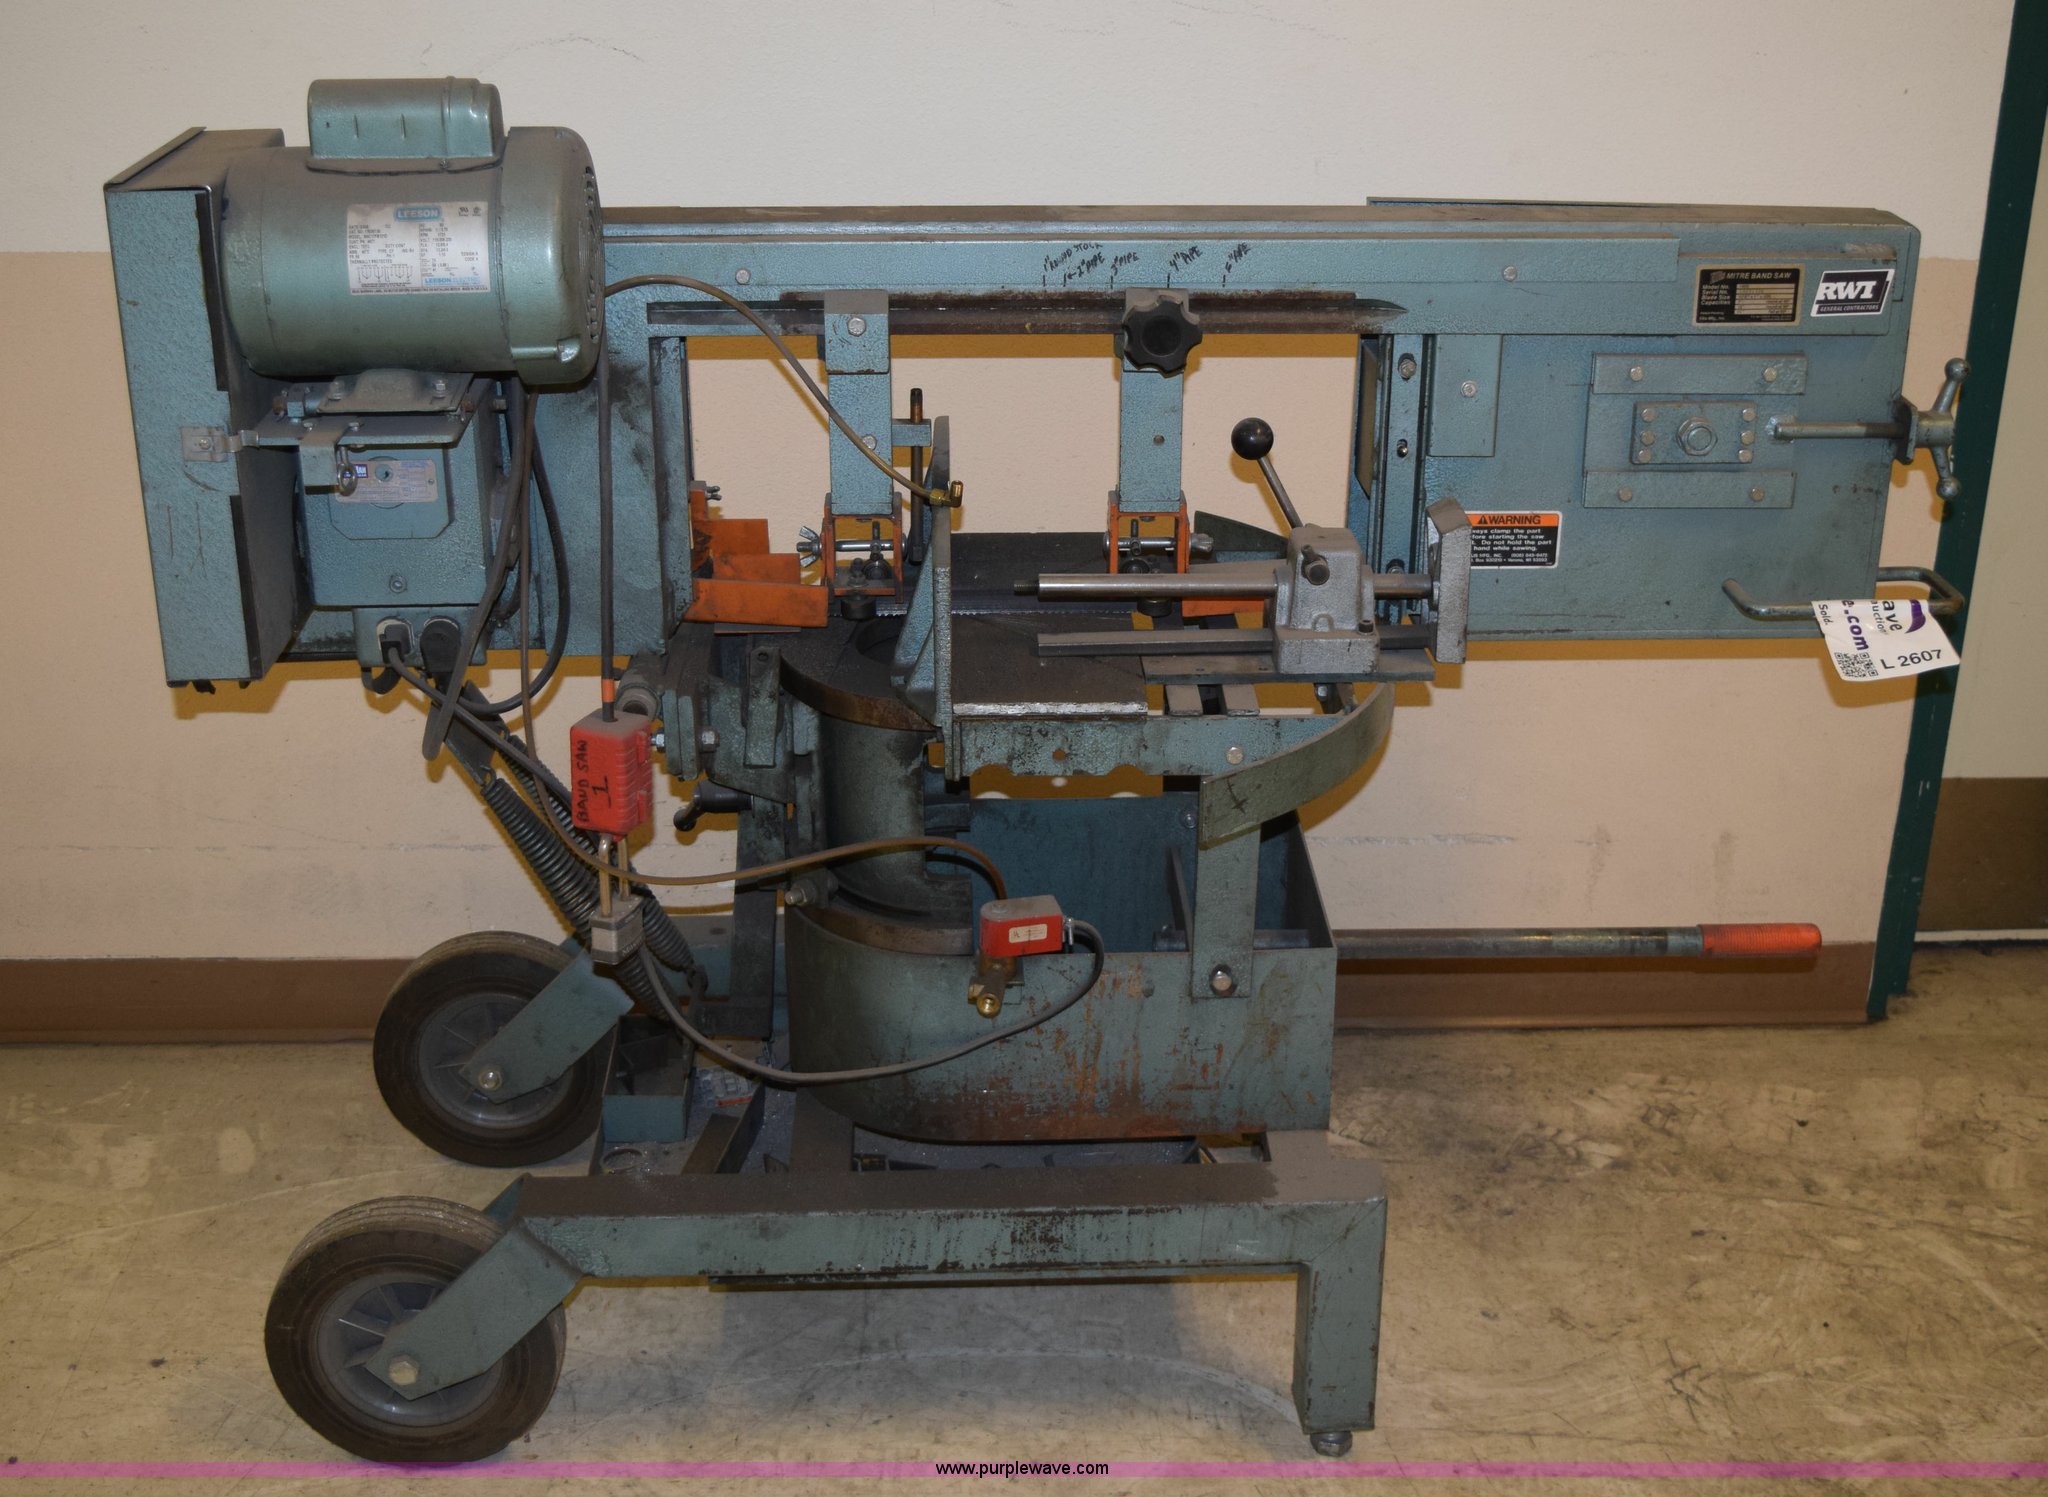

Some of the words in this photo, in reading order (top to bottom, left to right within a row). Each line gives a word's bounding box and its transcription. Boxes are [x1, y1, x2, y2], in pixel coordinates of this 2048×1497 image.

[397, 208, 439, 218] LEESON
[1815, 280, 1877, 300] RWI
[1488, 515, 1541, 525] WARNING
[1818, 603, 1833, 626] Sold.
[1841, 600, 1869, 651] e.com
[1882, 600, 1903, 632] ave
[1880, 658, 1895, 670] L
[1897, 649, 1942, 668] 2607
[576, 779, 590, 822] BAND
